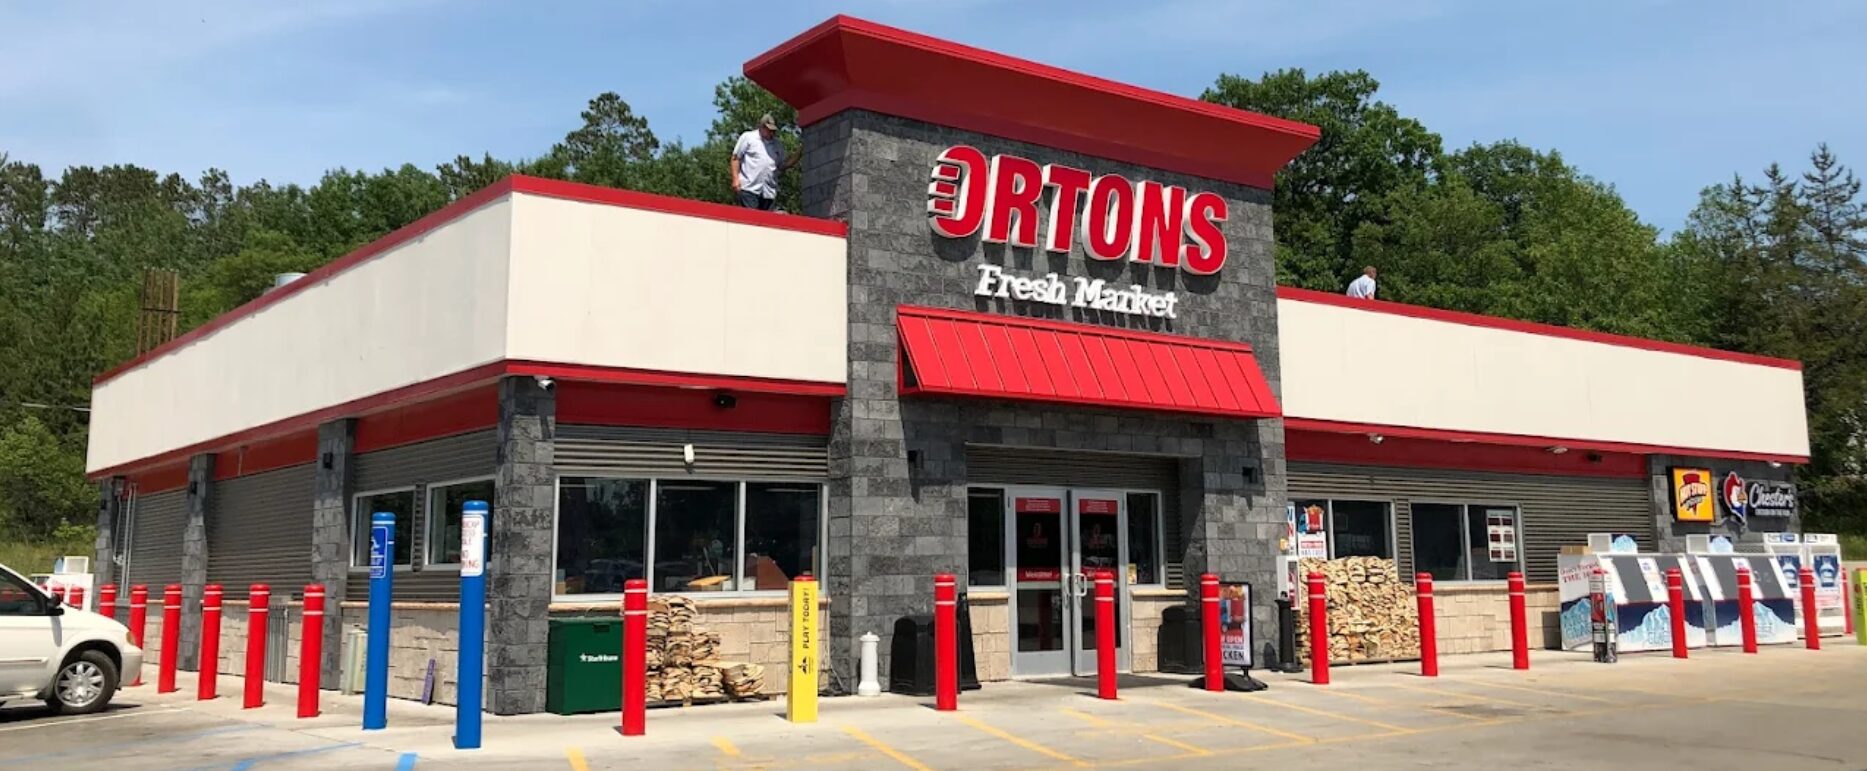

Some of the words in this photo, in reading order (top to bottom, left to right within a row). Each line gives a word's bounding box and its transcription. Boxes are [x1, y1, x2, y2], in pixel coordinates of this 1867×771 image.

[928, 145, 1228, 275] ORTONS
[974, 264, 1067, 305] Fresh
[1072, 276, 1179, 318] Market
[1749, 483, 1794, 508] Chester's
[802, 626, 810, 649] PLAY
